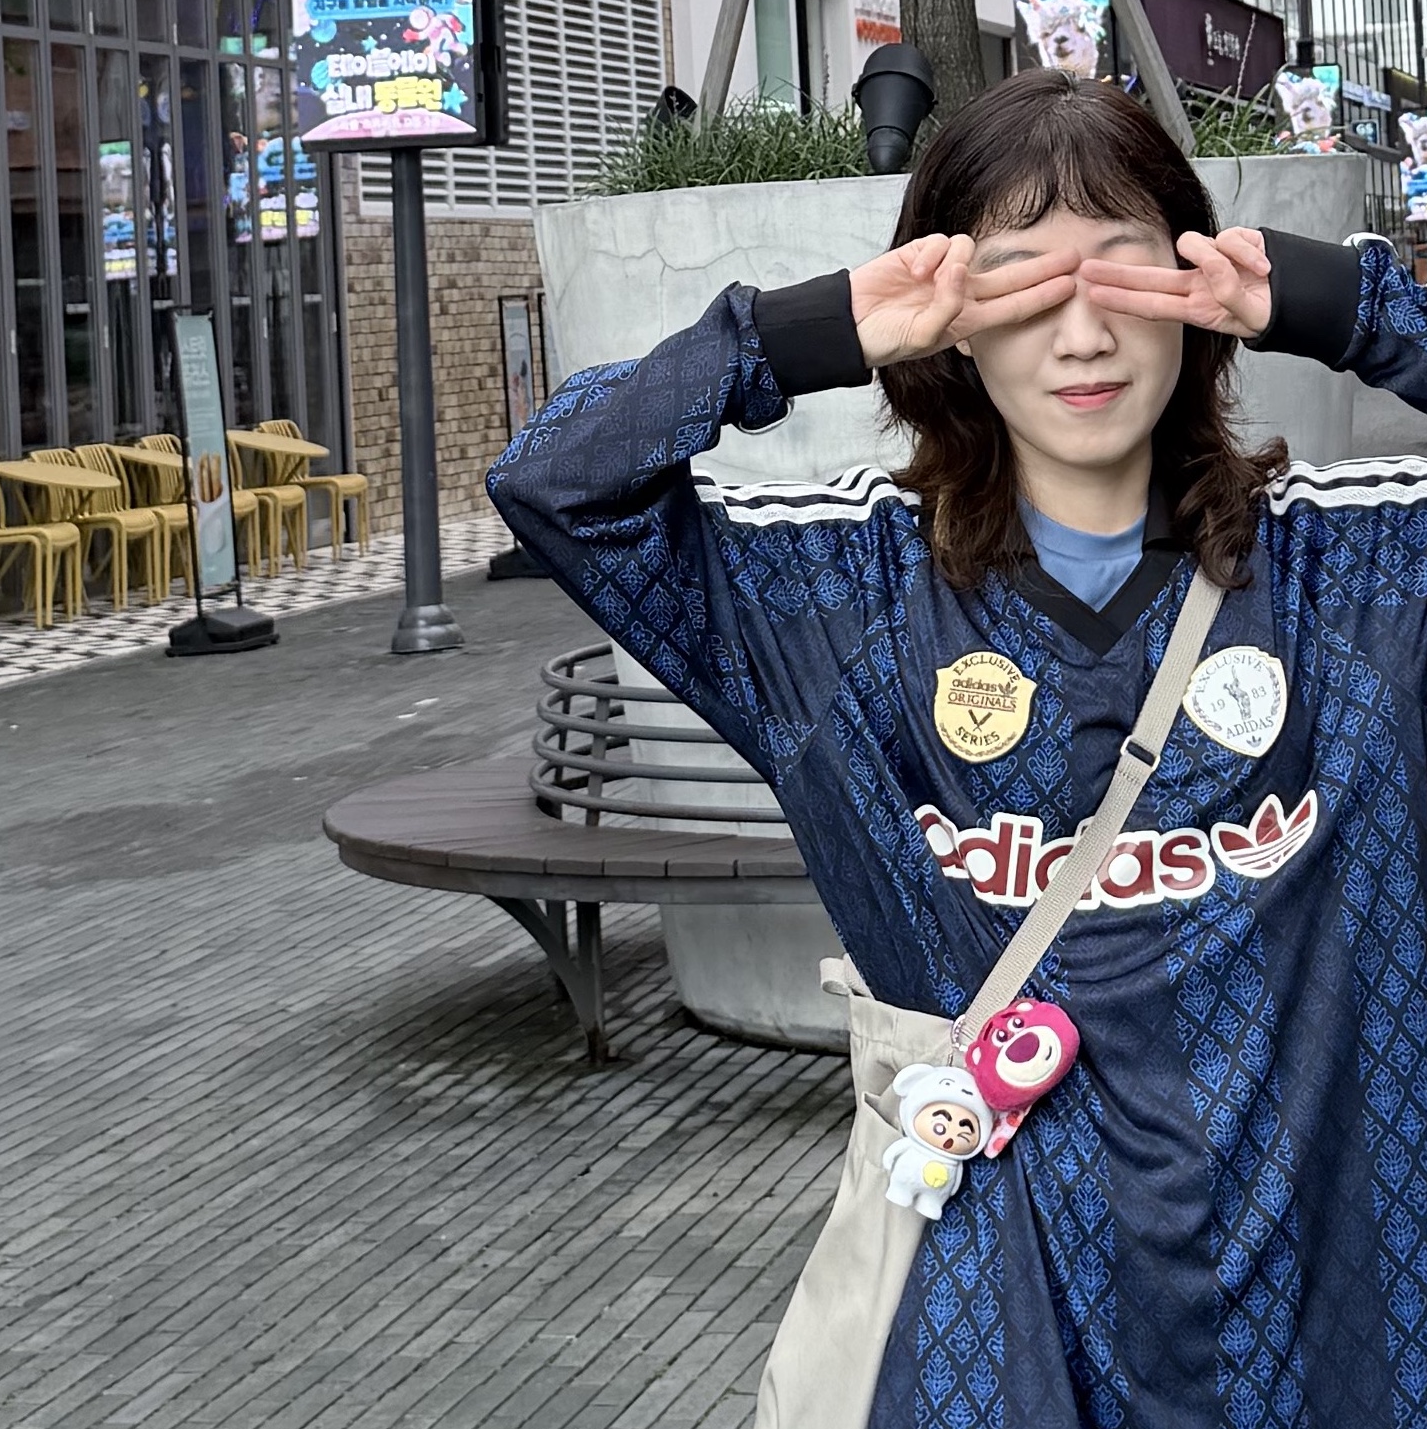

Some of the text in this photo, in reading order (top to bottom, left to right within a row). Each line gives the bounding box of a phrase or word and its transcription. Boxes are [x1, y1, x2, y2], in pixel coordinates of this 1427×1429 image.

[321, 76, 442, 115] 실내 동물원
[953, 655, 1020, 683] EXCLUSIVE
[1195, 654, 1265, 693] EXCLUSIVE
[952, 677, 997, 692] adidas
[948, 692, 1017, 709] ORIGINALS
[1211, 686, 1266, 712] 19 83
[955, 726, 1000, 746] SERIES
[1226, 716, 1274, 739] ADIDAS
